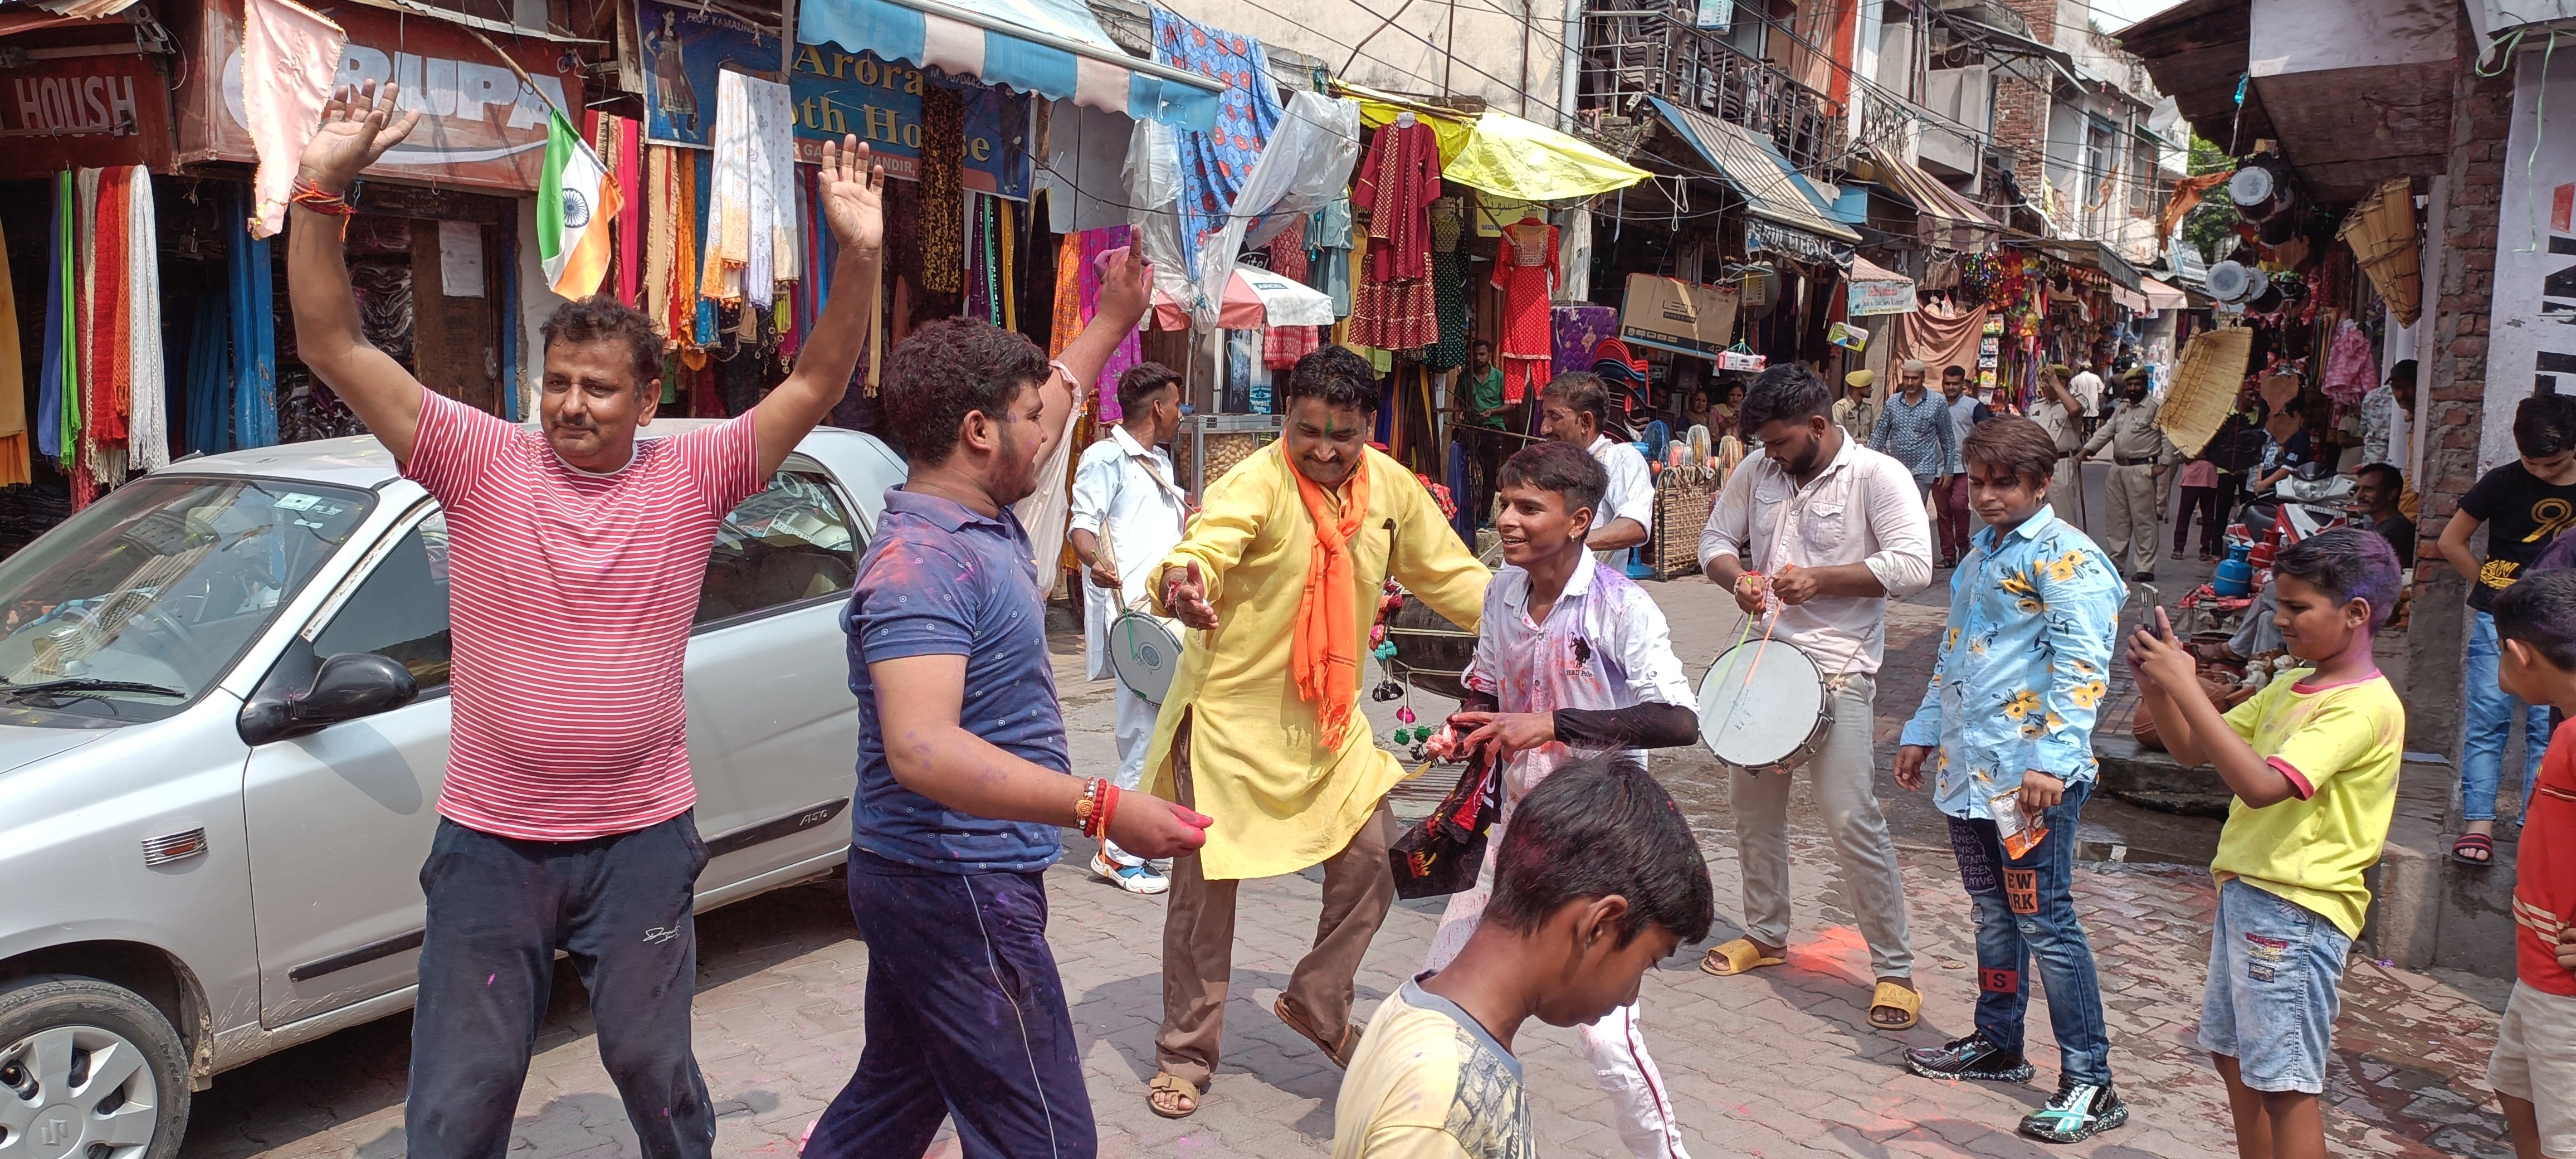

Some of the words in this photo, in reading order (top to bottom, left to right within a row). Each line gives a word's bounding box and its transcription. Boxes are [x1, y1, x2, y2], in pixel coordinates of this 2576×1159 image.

[687, 12, 710, 26] PROP.
[792, 45, 923, 96] Arora
[930, 67, 943, 79] M.
[1351, 202, 1372, 214] VISIO
[1247, 255, 1269, 270] itel
[1708, 344, 1722, 353] 42
[799, 809, 828, 826] ALTO
